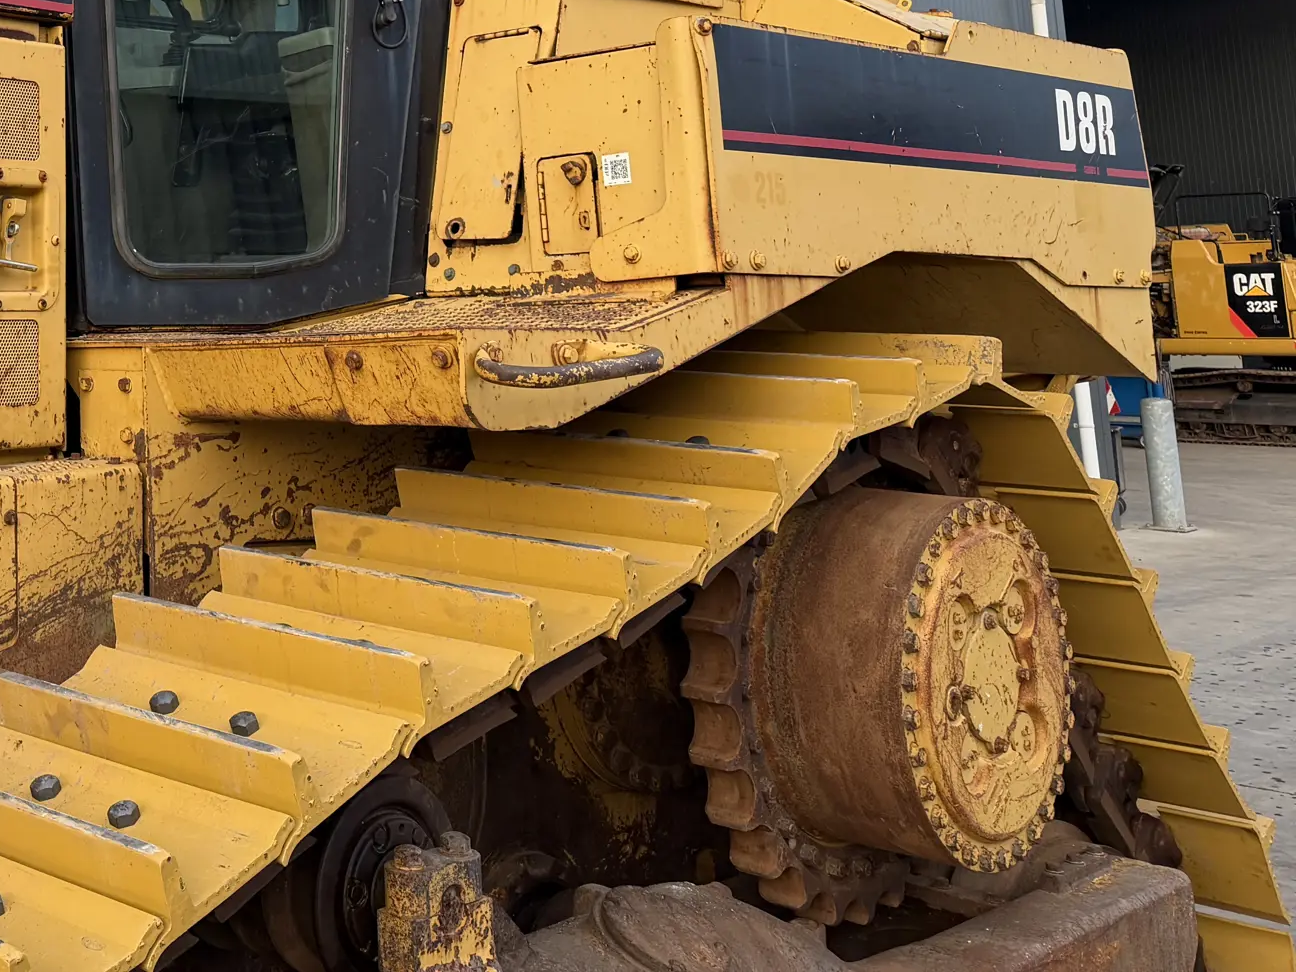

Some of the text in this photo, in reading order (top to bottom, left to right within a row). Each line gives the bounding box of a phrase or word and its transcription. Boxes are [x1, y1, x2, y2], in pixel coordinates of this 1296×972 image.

[1055, 88, 1116, 156] D8R
[754, 171, 787, 206] 215
[1232, 273, 1275, 297] CAT
[1246, 300, 1278, 313] 323F
